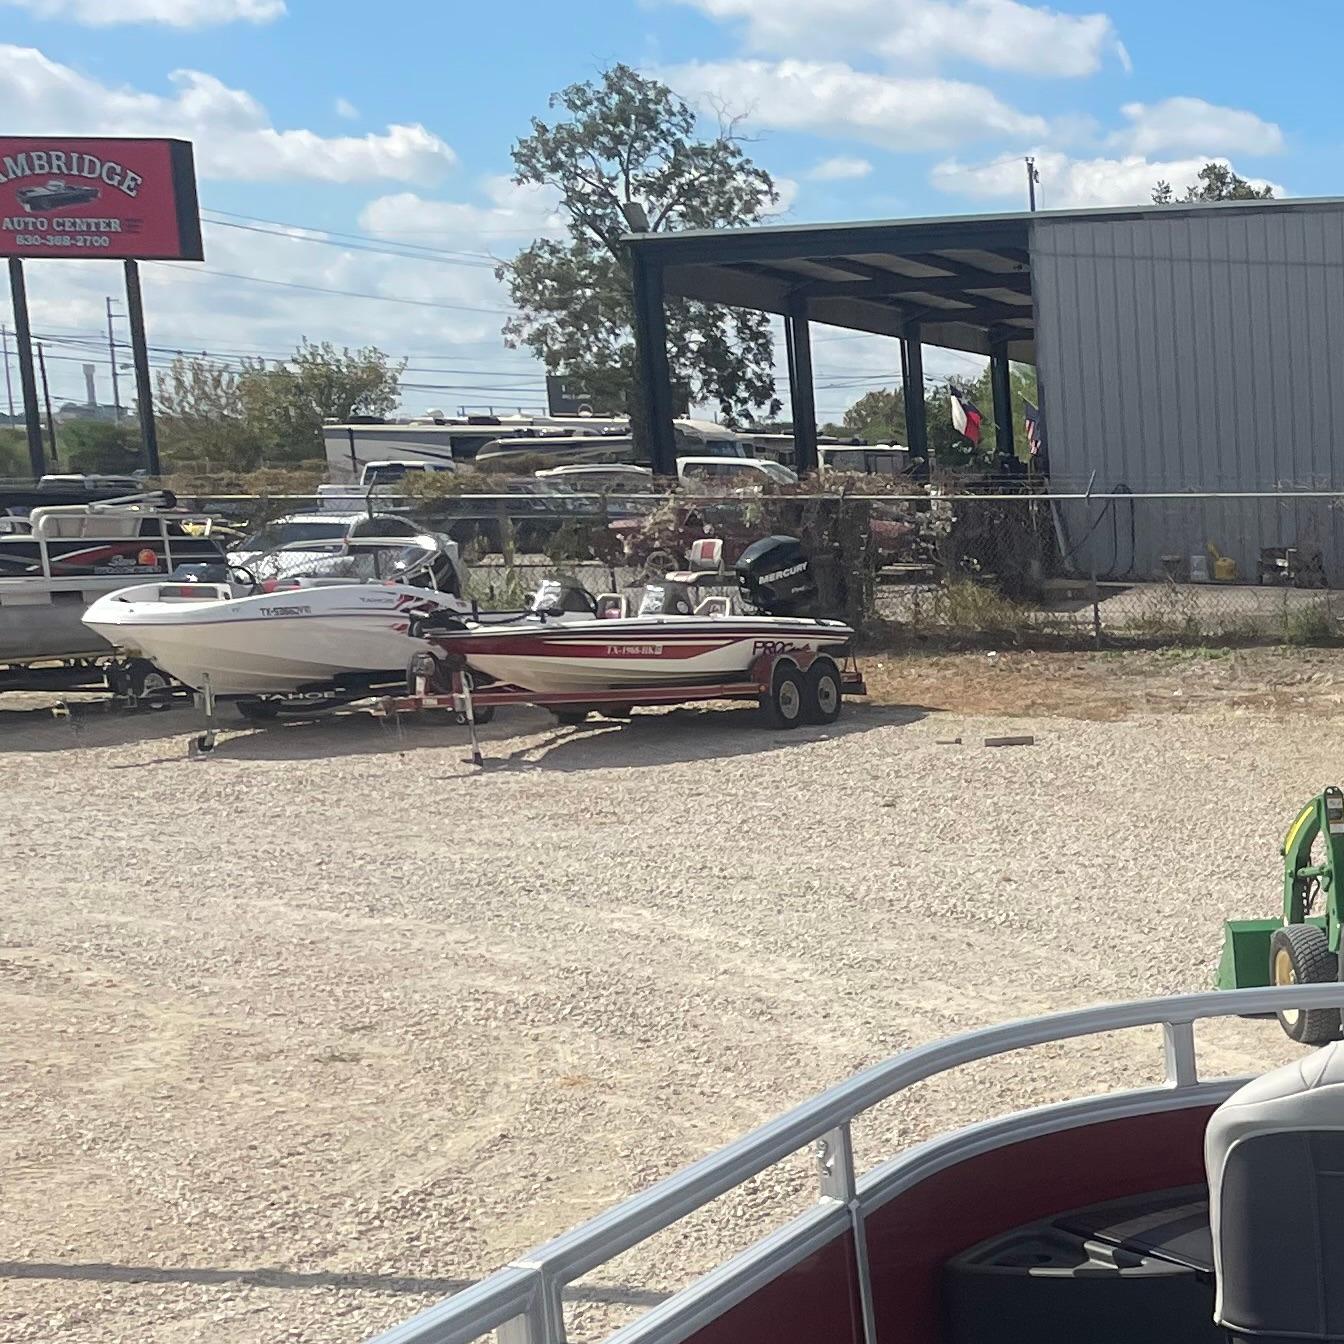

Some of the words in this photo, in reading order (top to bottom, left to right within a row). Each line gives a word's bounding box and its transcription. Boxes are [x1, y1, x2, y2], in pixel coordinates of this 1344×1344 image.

[2, 217, 48, 231] AUTO
[53, 218, 122, 232] CENTER
[759, 561, 808, 585] MERCURY
[257, 691, 337, 701] TAHOE
